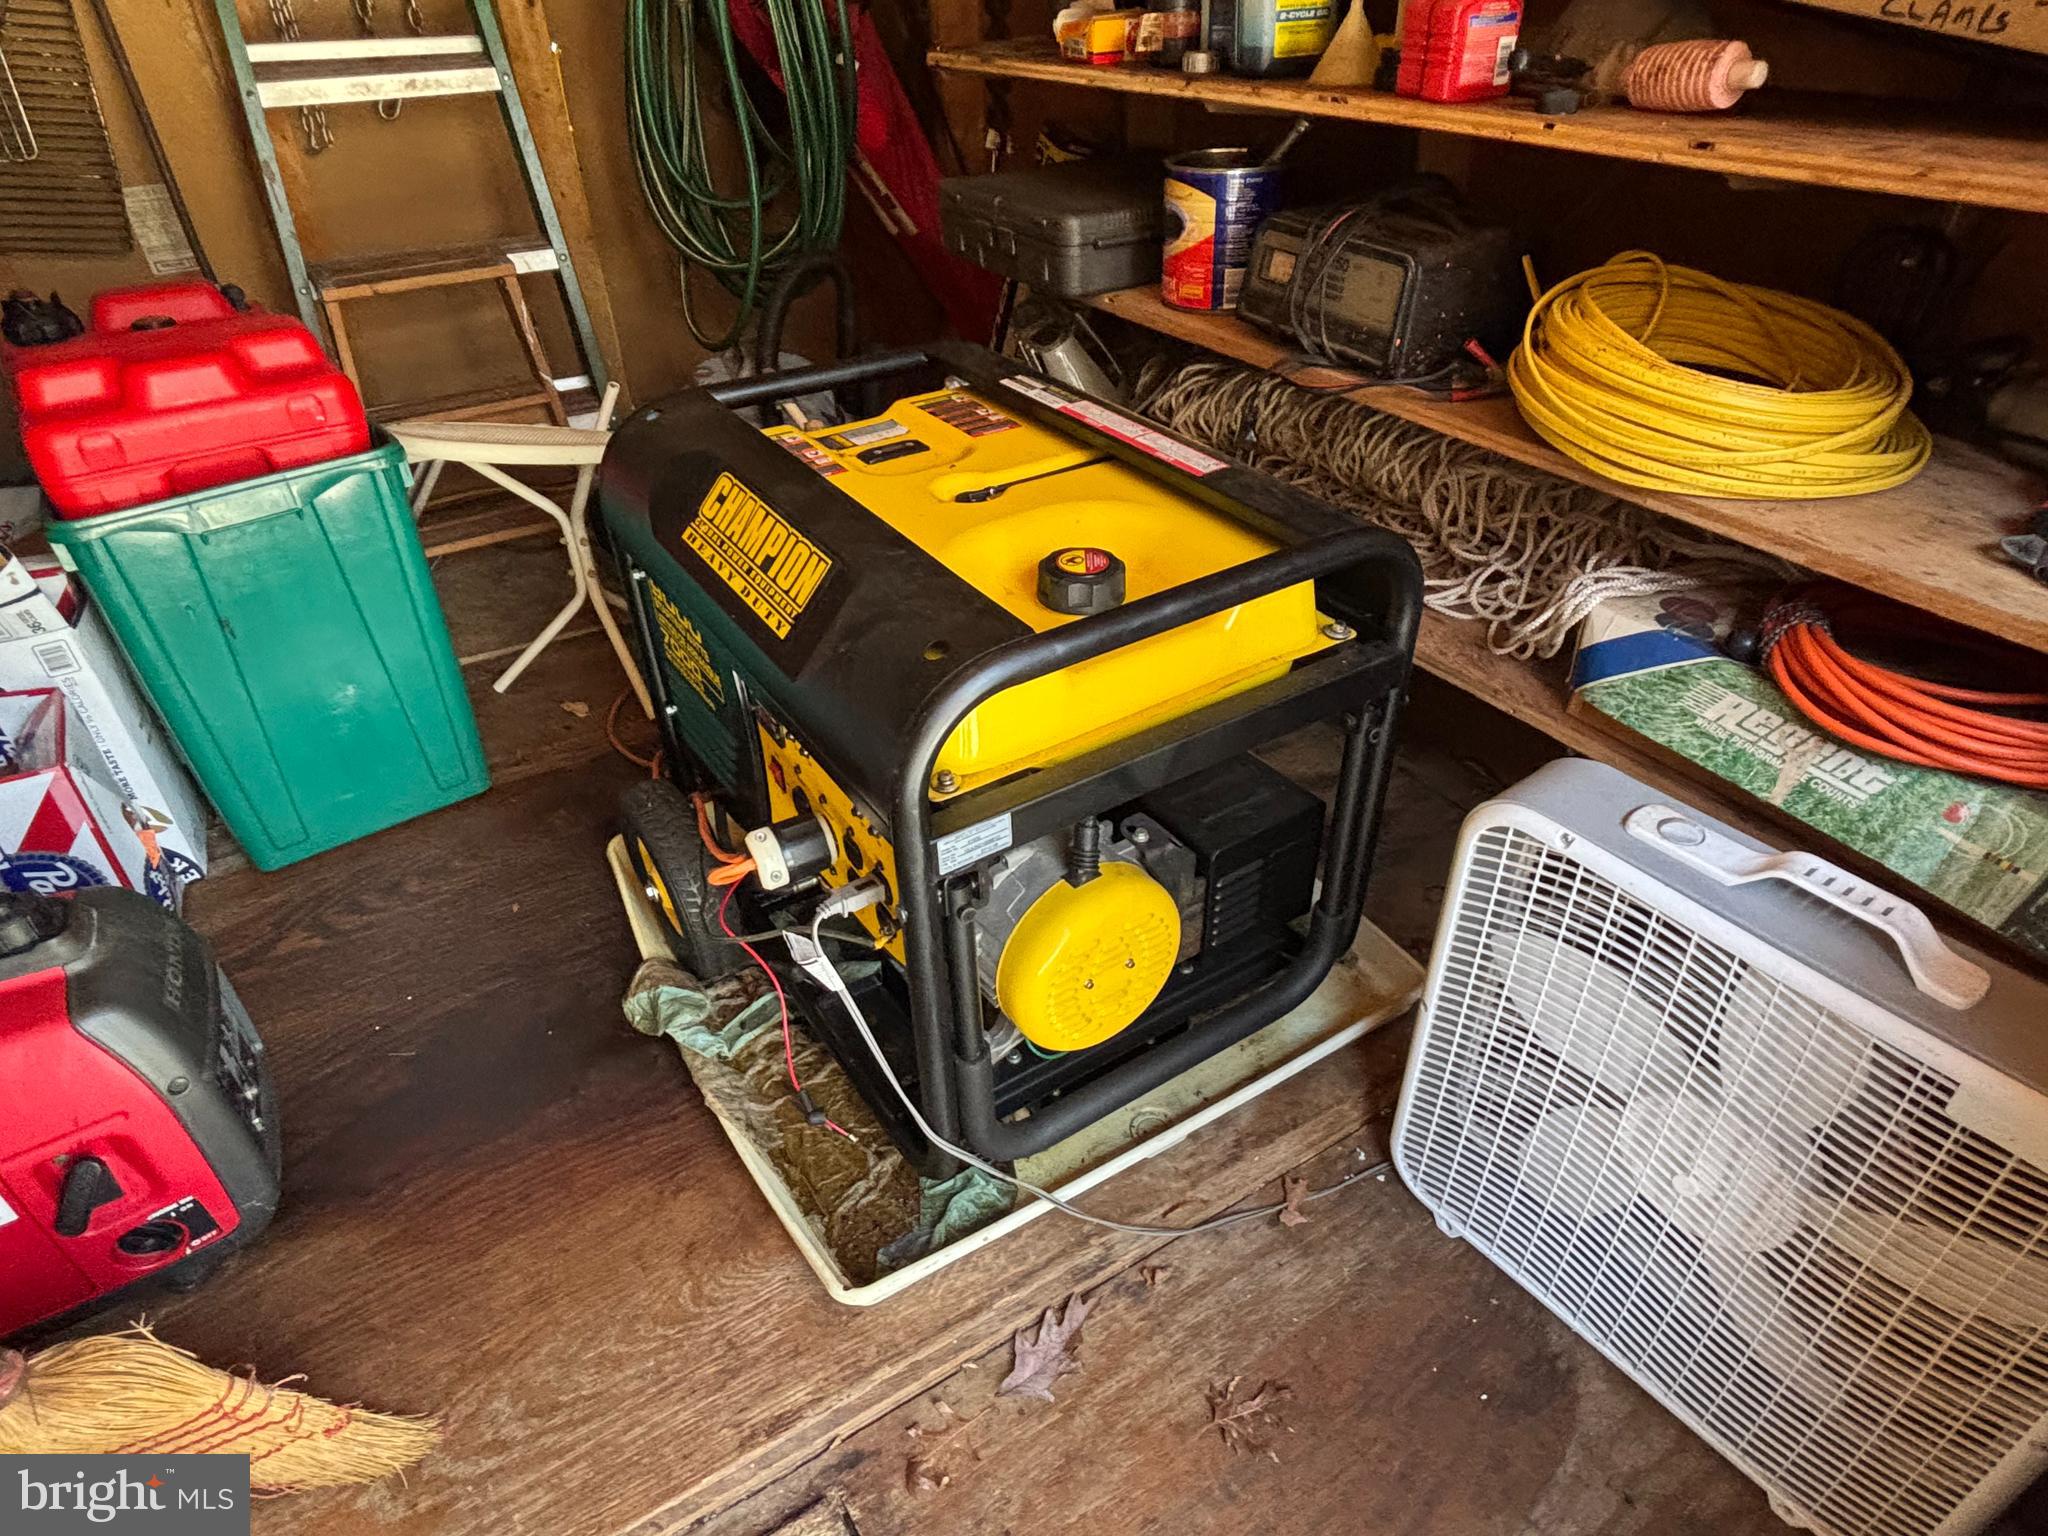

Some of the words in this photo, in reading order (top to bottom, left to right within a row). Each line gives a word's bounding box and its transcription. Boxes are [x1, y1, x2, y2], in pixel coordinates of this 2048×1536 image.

[686, 532, 737, 582] HEAVY
[740, 585, 786, 631] DUTY
[694, 517, 722, 547] GLOBAL
[721, 542, 751, 573] POWER
[749, 570, 798, 618] EQUIPMENT
[700, 474, 828, 608] CHAMPION
[102, 748, 123, 776] TASTE
[118, 776, 138, 801] MORE
[1696, 716, 1732, 741] WHERE
[1810, 778, 1859, 810] COUNTS
